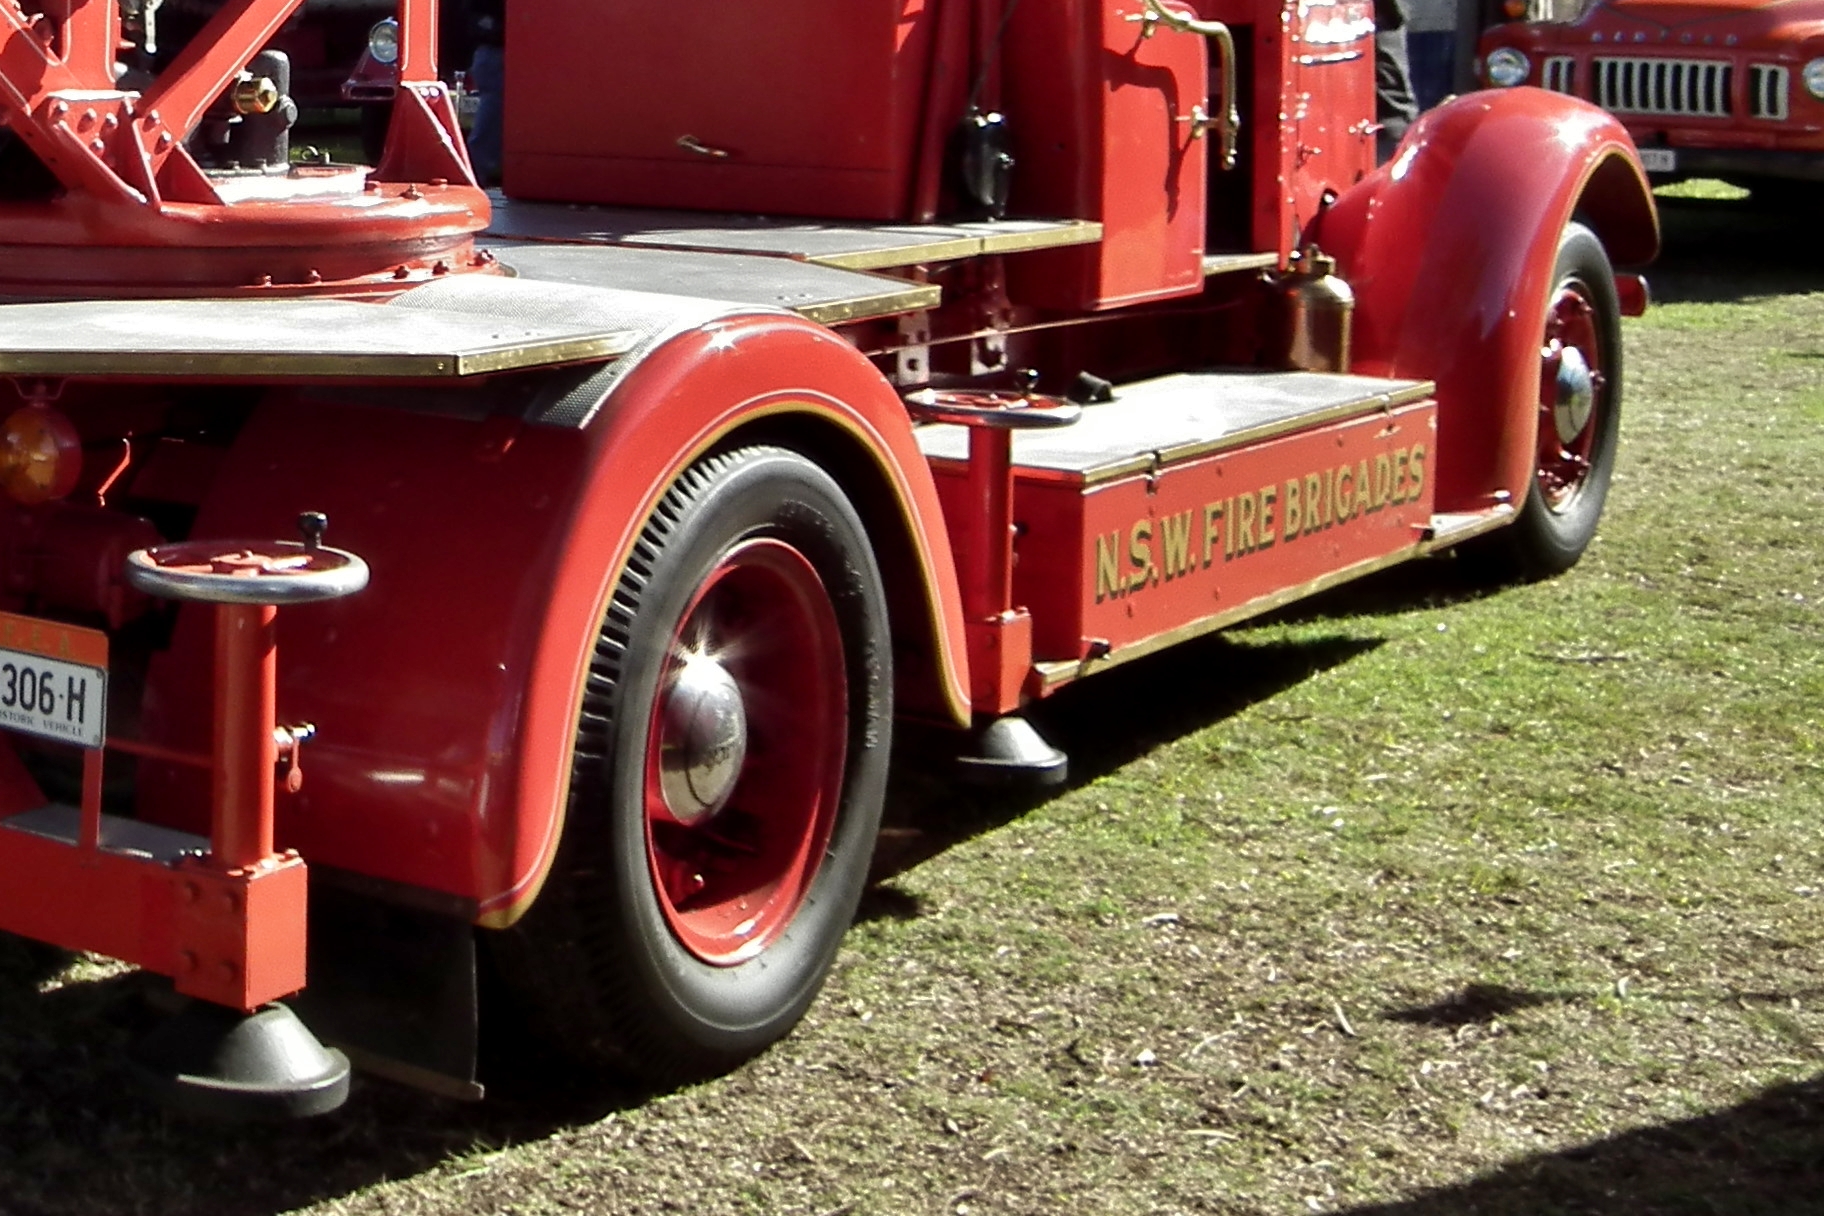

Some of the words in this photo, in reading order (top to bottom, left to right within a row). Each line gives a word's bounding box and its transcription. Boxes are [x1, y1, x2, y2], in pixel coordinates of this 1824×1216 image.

[1095, 509, 1197, 603] N.S.W.
[1202, 484, 1278, 569] FIRE
[1283, 443, 1427, 542] BRIGADES
